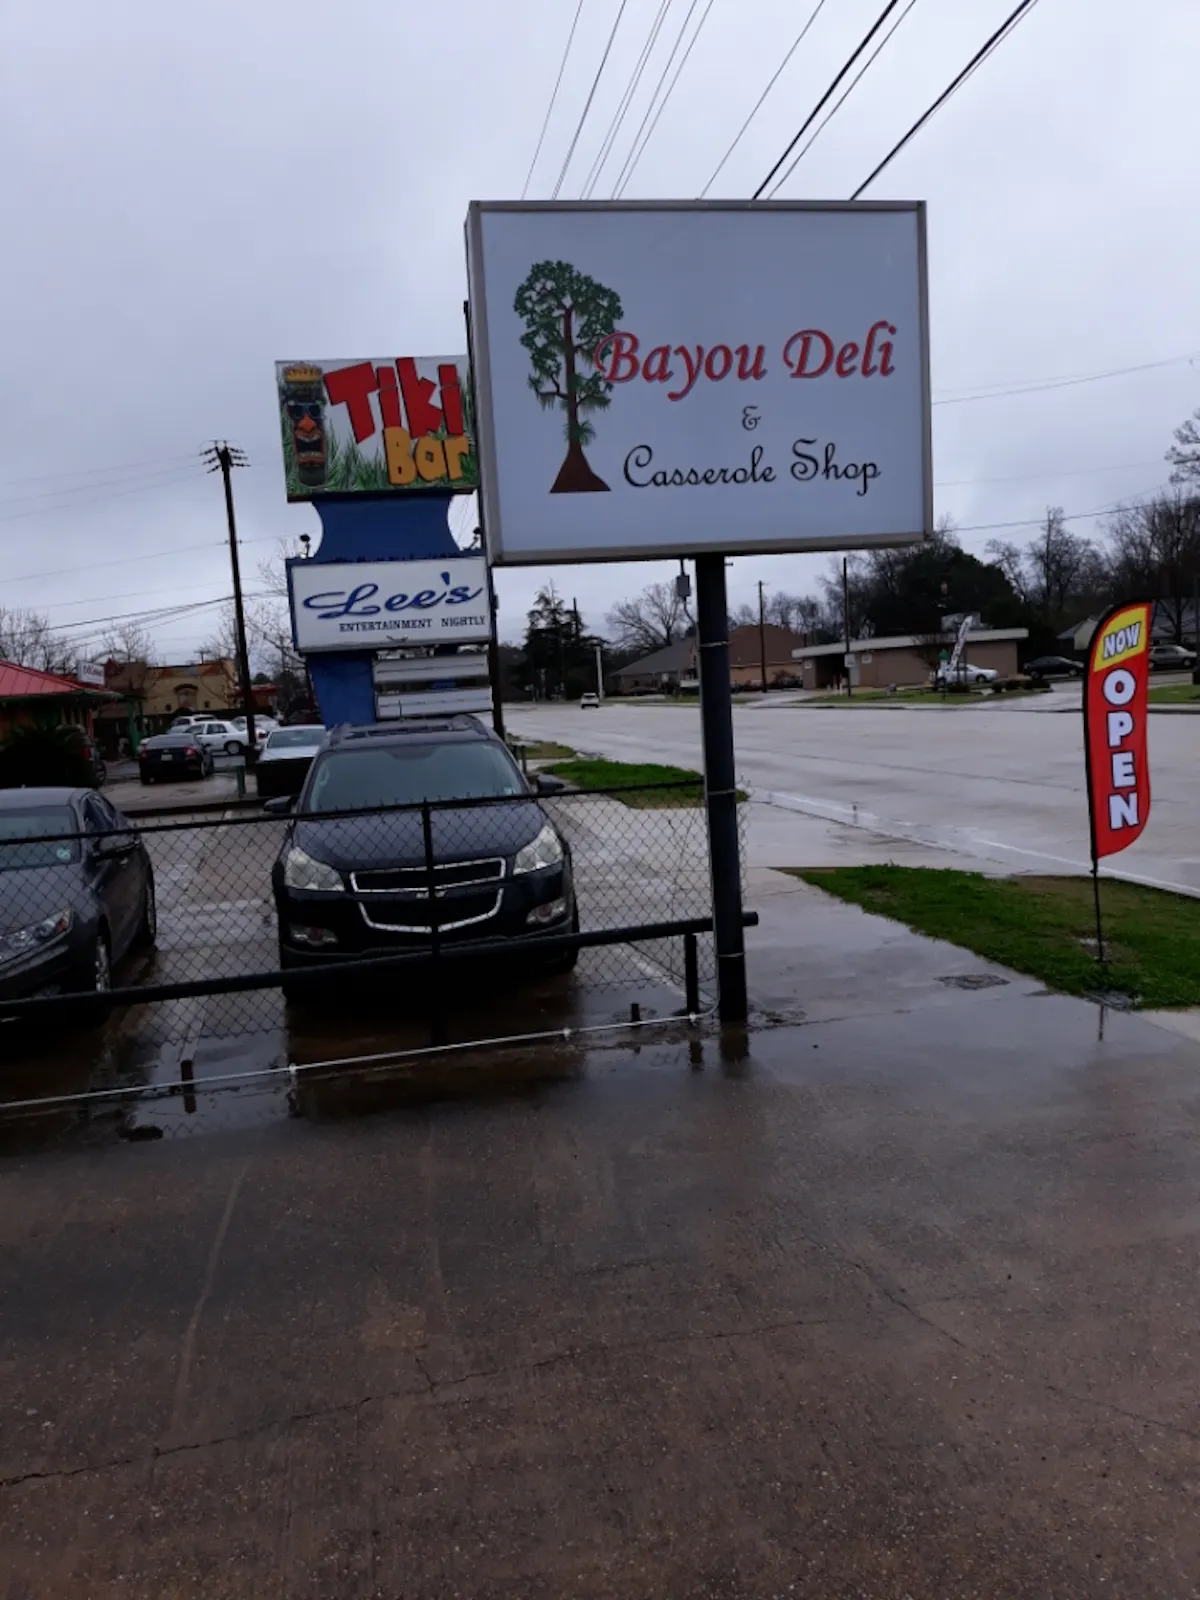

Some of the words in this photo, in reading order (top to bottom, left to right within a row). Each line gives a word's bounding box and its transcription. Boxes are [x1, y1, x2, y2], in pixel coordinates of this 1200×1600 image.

[594, 331, 767, 401] Bayou
[783, 320, 896, 379] Deli
[323, 357, 464, 444] Tiki
[741, 405, 761, 430] &
[383, 426, 469, 485] Bar
[623, 444, 776, 488] Casserole
[790, 438, 881, 496] Shop
[303, 572, 483, 619] Lee's
[339, 618, 433, 632] ENTERTAINMENT
[441, 615, 486, 627] NIGHTLY
[1102, 621, 1141, 660] NOW
[1103, 668, 1139, 830] OPEN
